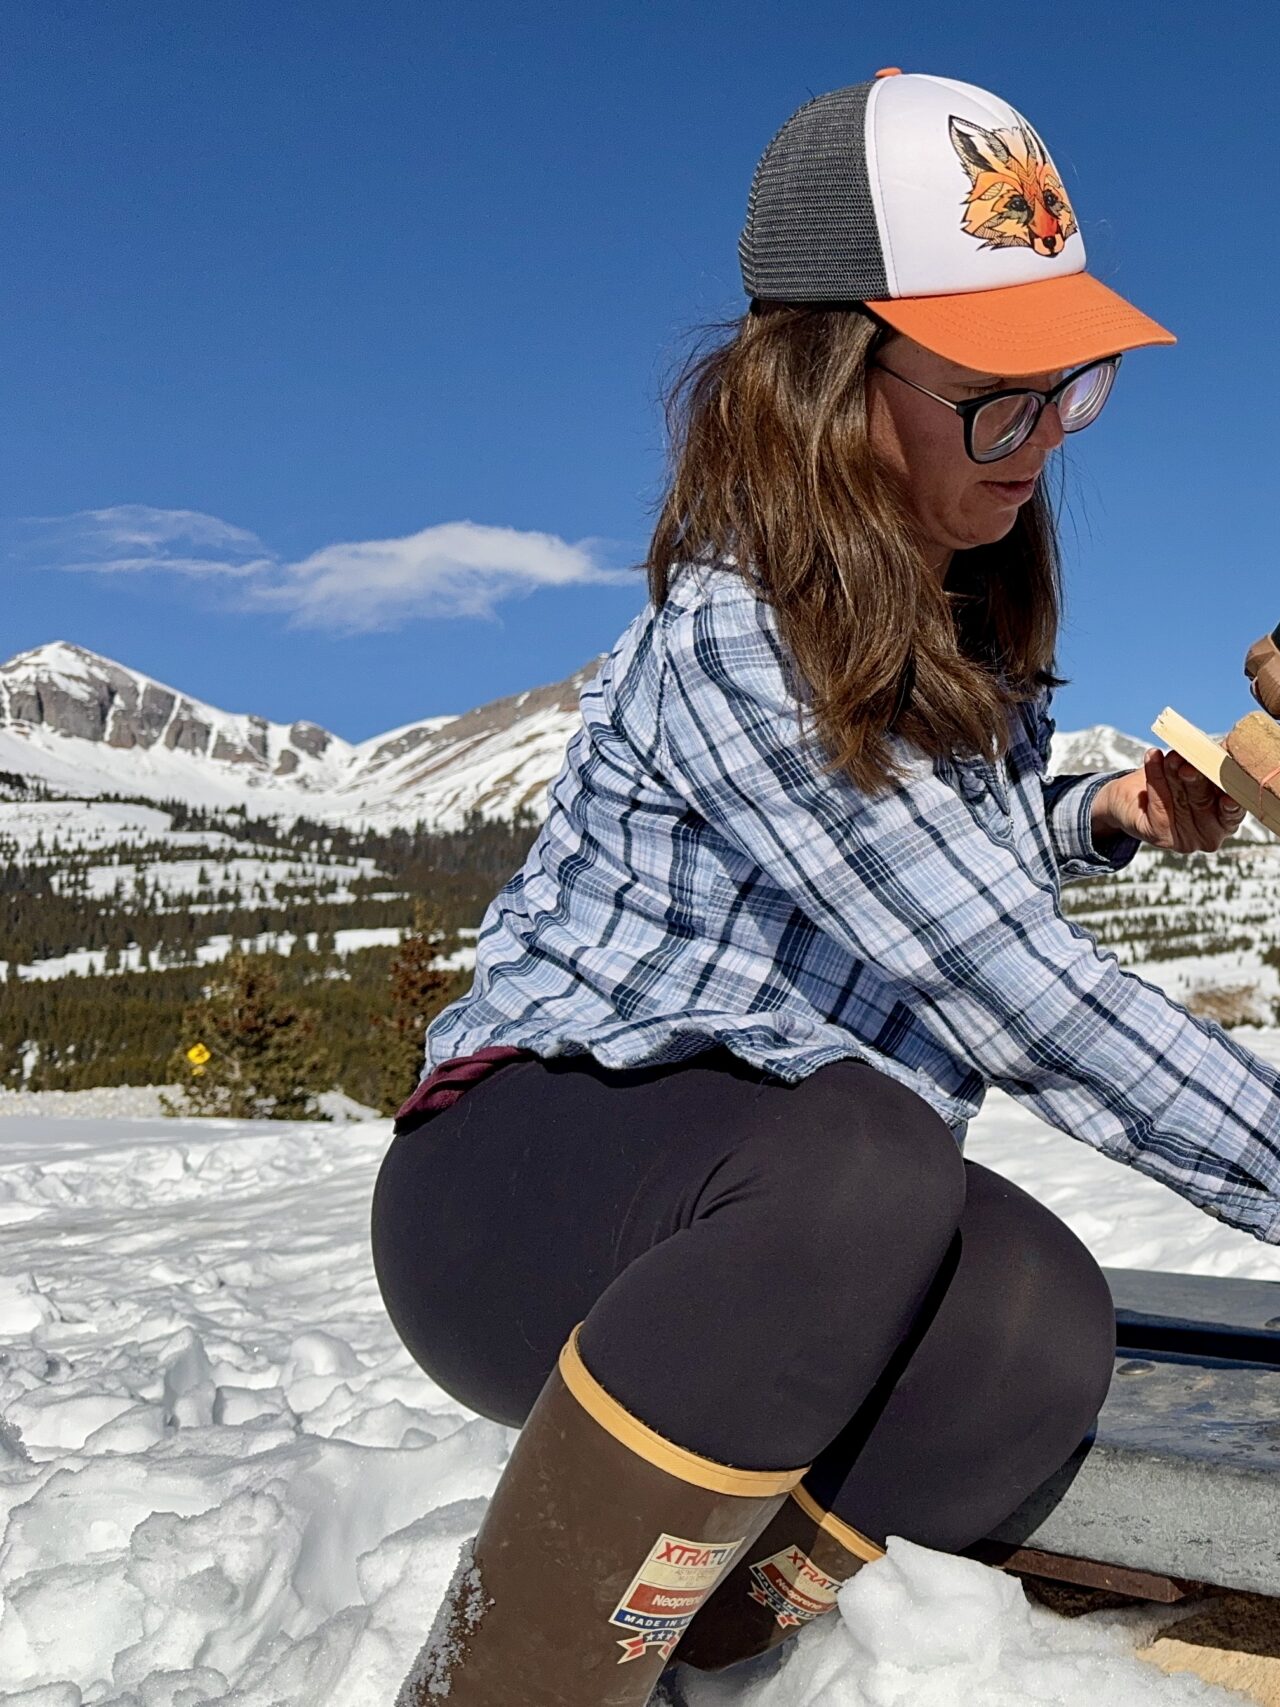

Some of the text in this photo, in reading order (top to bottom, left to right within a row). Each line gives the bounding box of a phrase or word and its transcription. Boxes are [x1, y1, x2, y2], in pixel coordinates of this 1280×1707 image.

[656, 1542, 736, 1566] XTRATU
[776, 1579, 823, 1609] Neoprene
[624, 1614, 662, 1627] MADE
